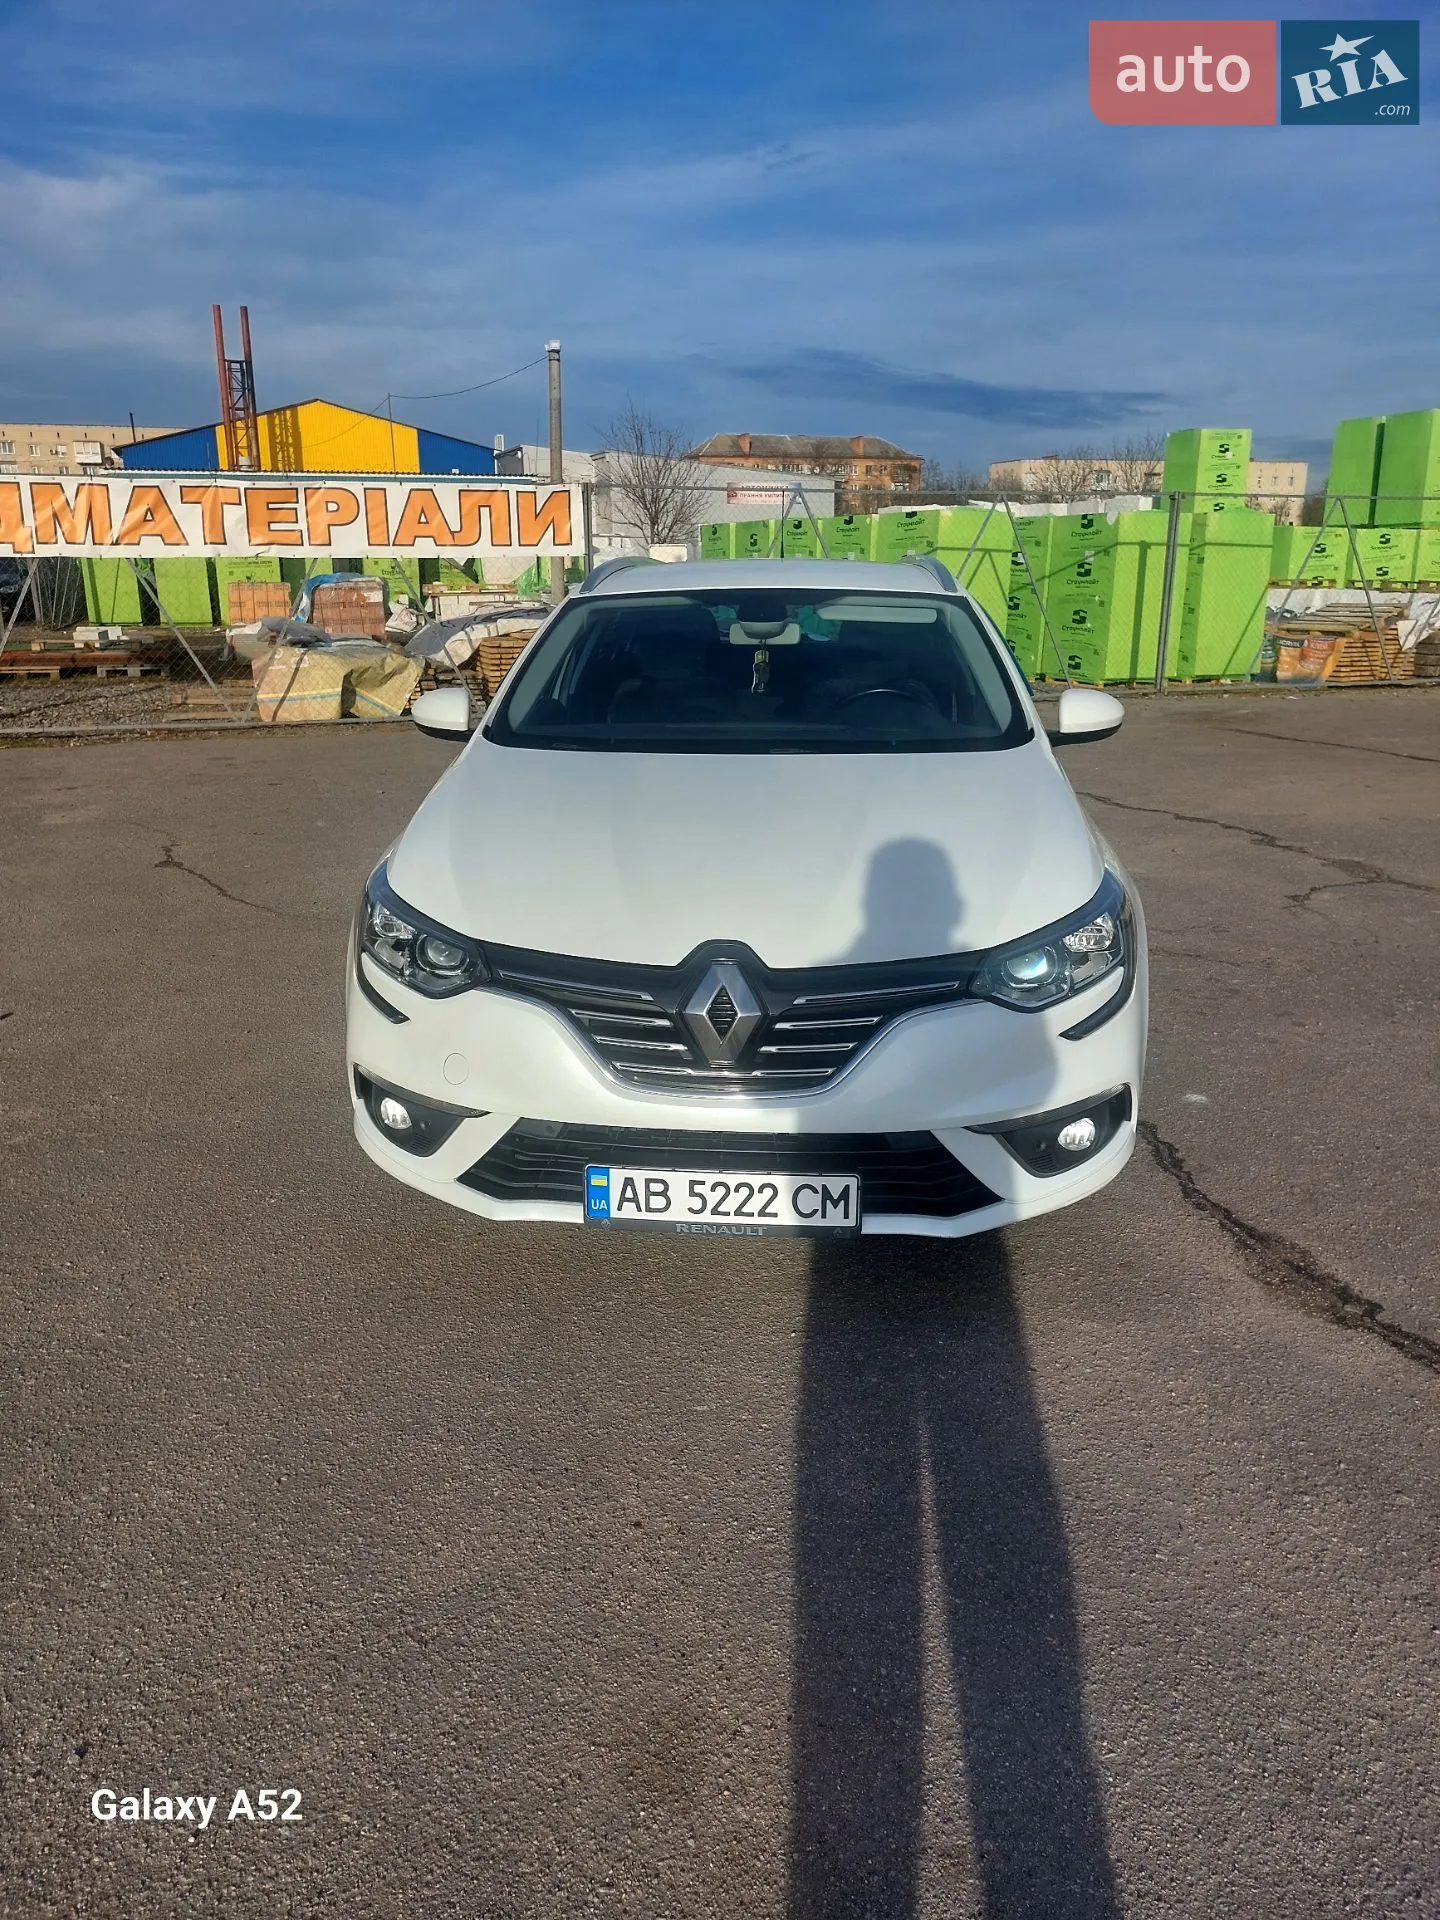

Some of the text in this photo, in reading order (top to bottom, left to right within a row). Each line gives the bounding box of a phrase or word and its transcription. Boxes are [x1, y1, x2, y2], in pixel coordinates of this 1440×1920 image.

[591, 1199, 608, 1210] UA
[616, 1176, 850, 1220] AB 5222 CM
[675, 1223, 768, 1236] RENAULT
